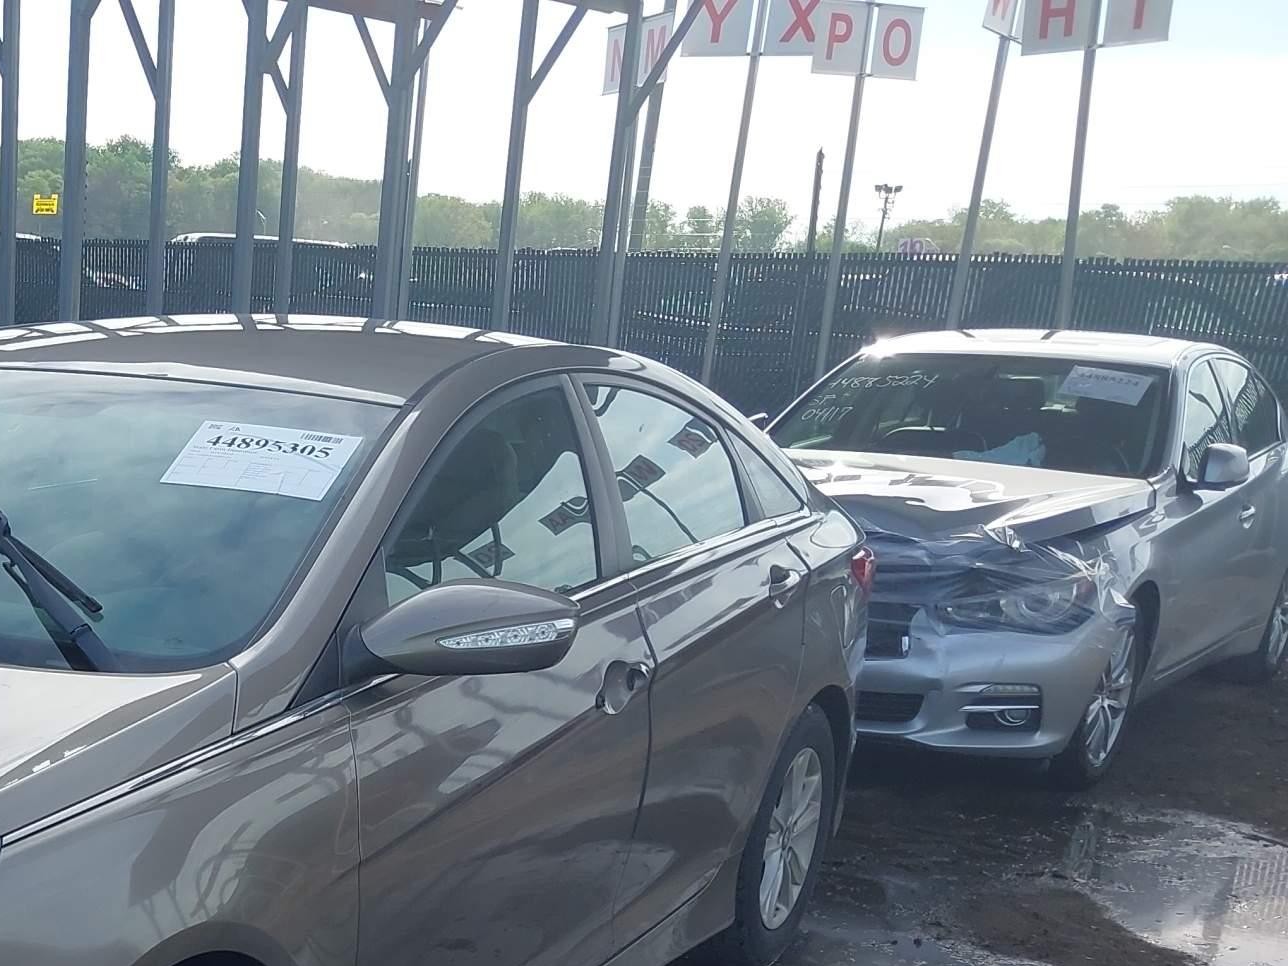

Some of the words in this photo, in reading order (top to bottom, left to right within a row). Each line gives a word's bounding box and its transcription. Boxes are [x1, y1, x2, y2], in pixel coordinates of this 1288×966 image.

[701, 0, 739, 44] Y
[778, 0, 816, 43] X
[824, 12, 854, 61] P
[882, 18, 913, 67] O
[1039, 0, 1077, 40] H
[206, 435, 334, 459] 44895305
